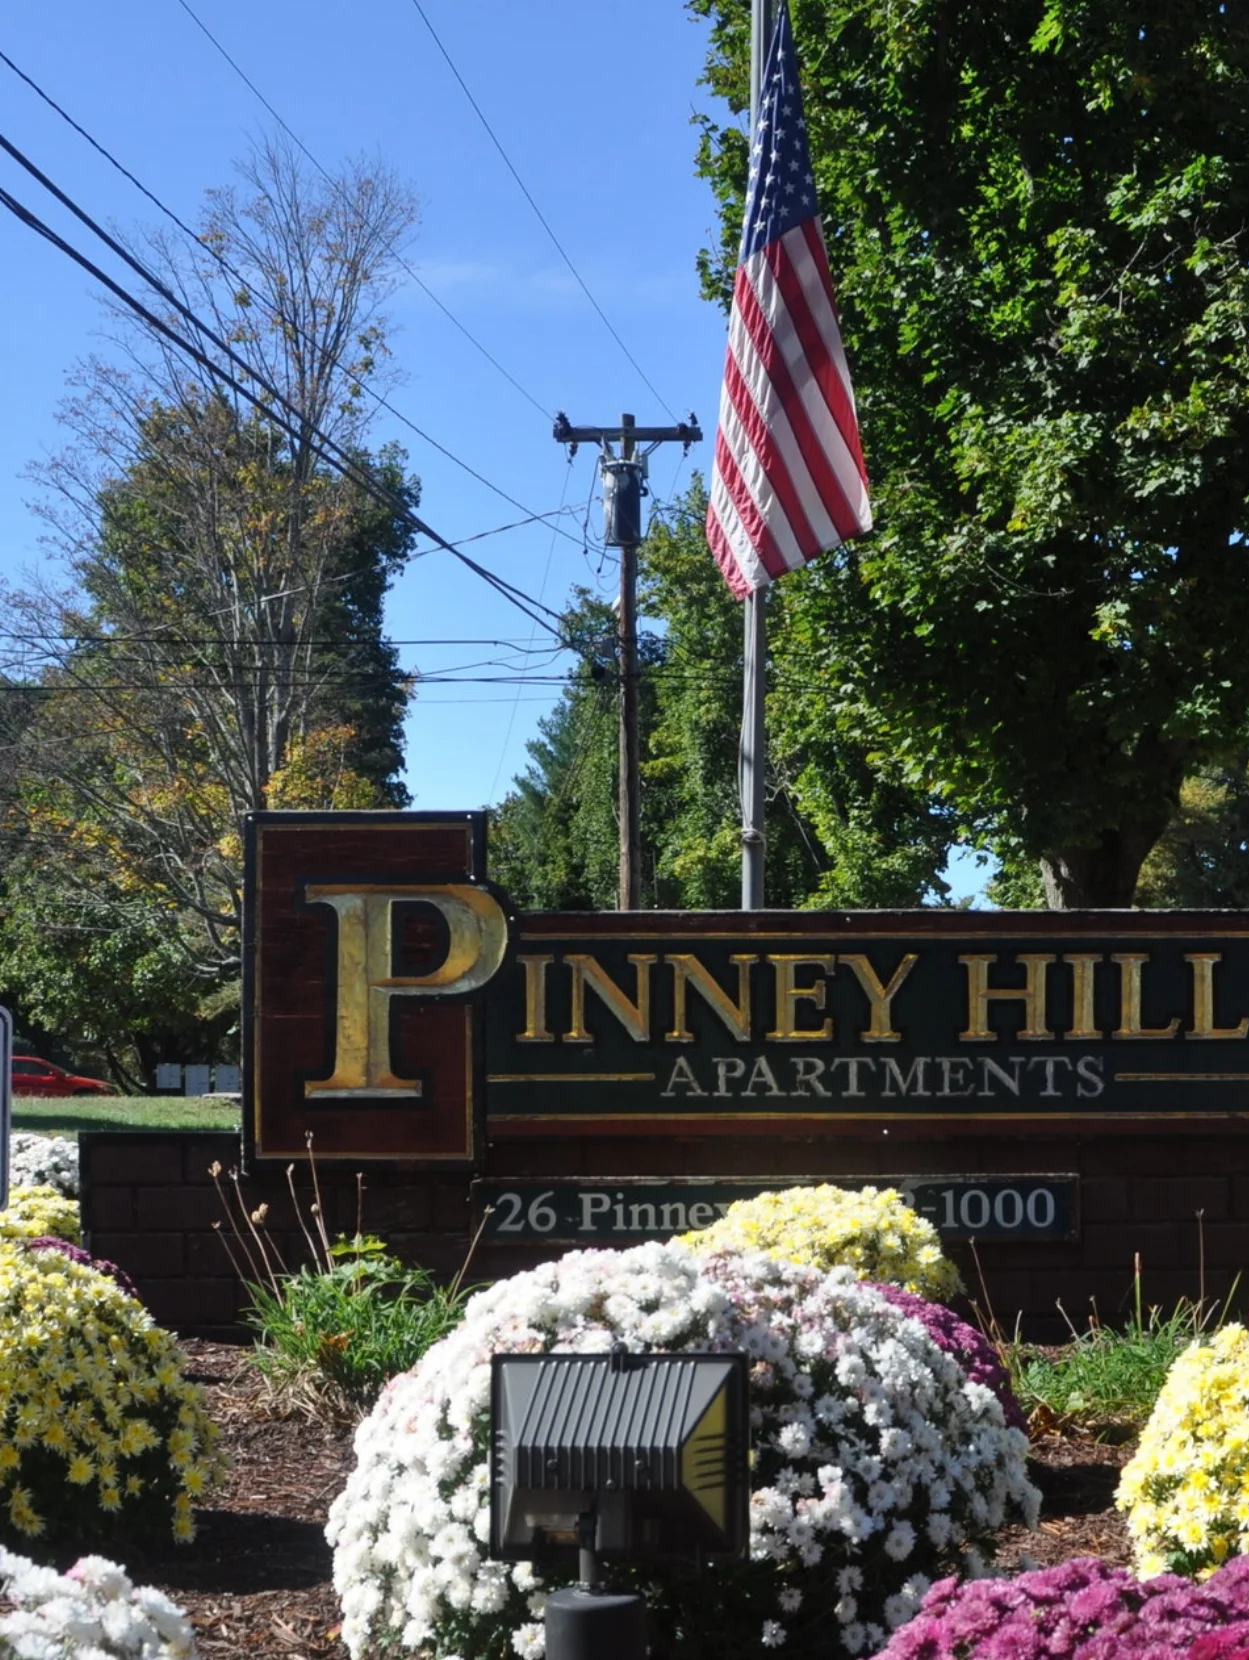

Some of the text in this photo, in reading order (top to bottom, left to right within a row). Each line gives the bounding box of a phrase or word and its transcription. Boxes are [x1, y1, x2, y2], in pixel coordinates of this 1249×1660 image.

[304, 883, 919, 1099] PINNEY
[660, 1055, 1106, 1098] APARTMENTS
[496, 1190, 557, 1232] 26
